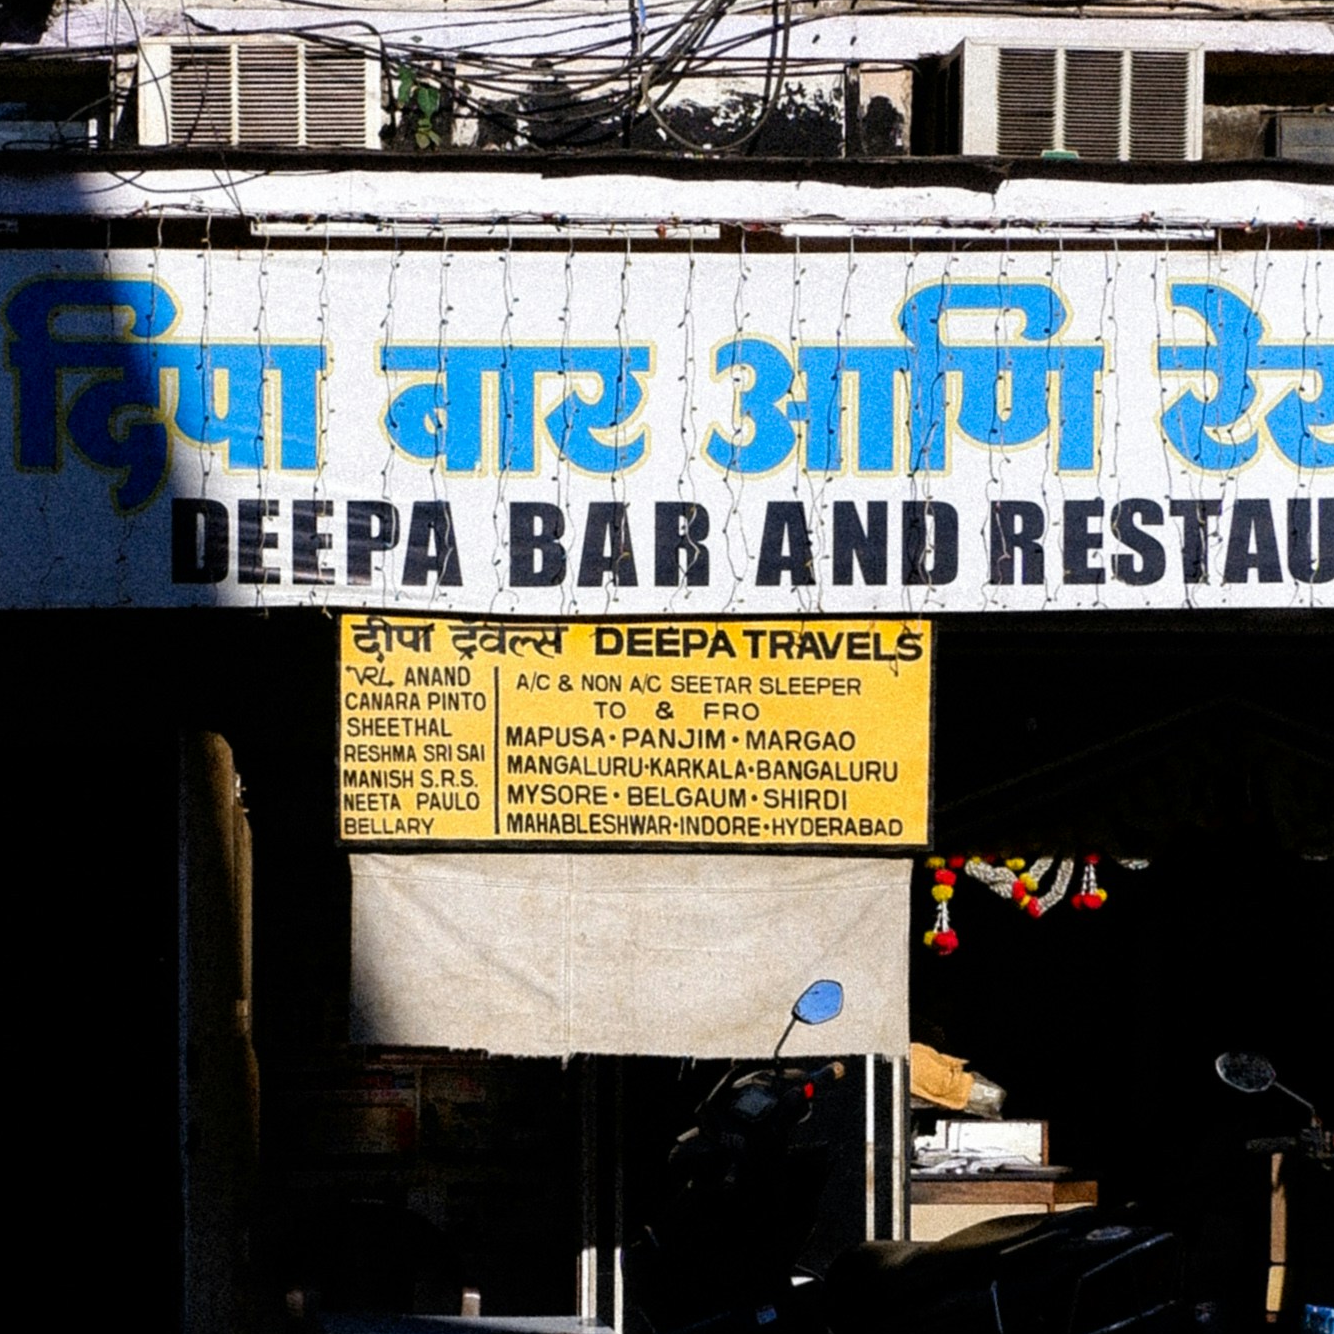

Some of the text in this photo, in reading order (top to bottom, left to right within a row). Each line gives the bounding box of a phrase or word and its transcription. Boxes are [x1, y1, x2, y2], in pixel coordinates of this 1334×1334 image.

[2, 274, 330, 515] दिपा
[375, 338, 657, 474] बार
[705, 275, 1106, 476] आणि
[171, 499, 464, 587] DEEPA
[508, 500, 710, 588] BAR
[754, 499, 960, 587] AND
[351, 617, 436, 663] दीपा
[594, 626, 924, 662] DEEPA TRAVELS
[345, 665, 471, 687] VRL ANAND
[516, 671, 861, 696] A/C & NON A/C SEETAR SLEEPER
[344, 691, 487, 711] CANARA PINTO
[593, 700, 760, 721] TO & FRO
[346, 717, 452, 737] SHEETHAL
[506, 725, 856, 751] MAPUSA PANJIM MARGAO
[343, 743, 485, 763] RESHMA SRI SAI
[343, 769, 478, 788] MANISH S.R.S.
[507, 754, 899, 782] MANGALURU KARKALA BANGALURU
[343, 791, 480, 811] NEETA PAULO
[507, 783, 847, 811] MYSORE BELGAUM SHIRDI
[343, 817, 434, 835] BELLARY
[507, 812, 904, 837] MAHABLESHWAR INDORE HYDERABAD
